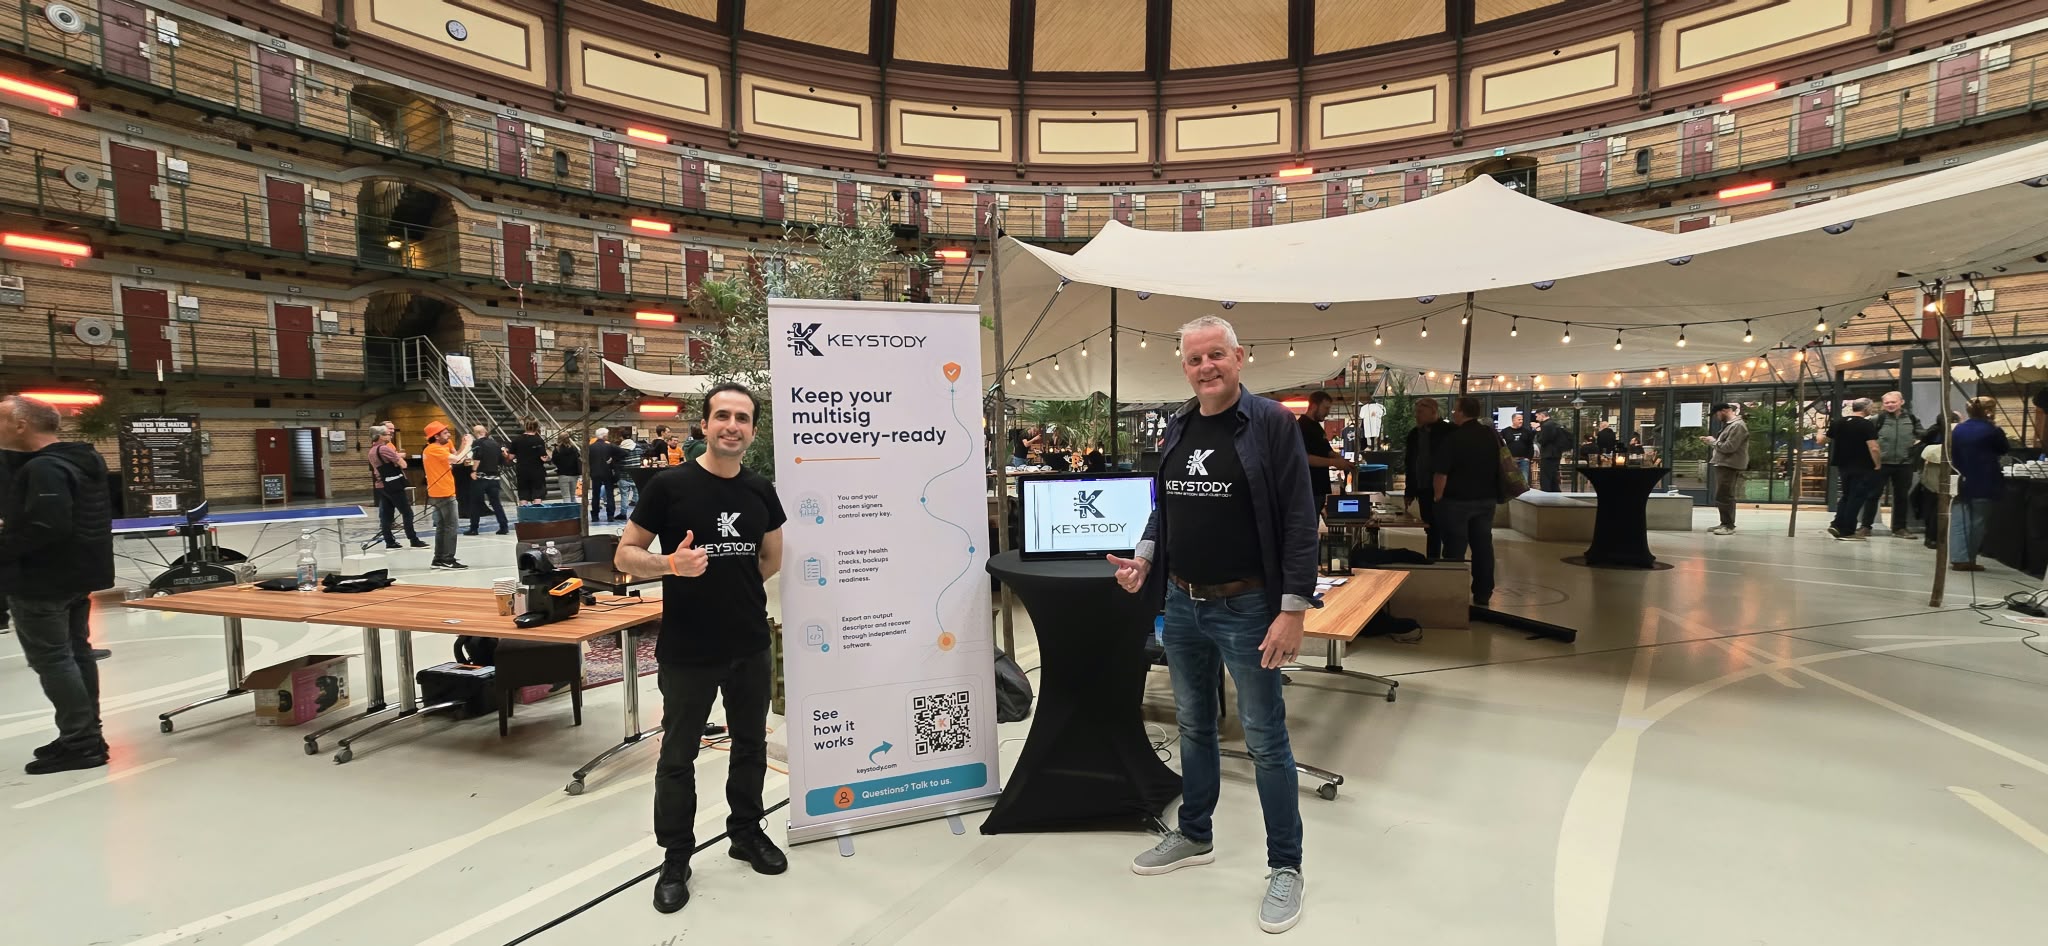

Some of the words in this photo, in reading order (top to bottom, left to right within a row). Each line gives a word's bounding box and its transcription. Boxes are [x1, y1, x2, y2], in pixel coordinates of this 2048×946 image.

[828, 334, 927, 348] KEYSTODY
[791, 387, 843, 406] Keep
[849, 391, 892, 406] your
[793, 407, 870, 427] multisig
[793, 427, 946, 447] recovery-ready
[1166, 480, 1232, 492] KEYSTODY
[1052, 523, 1127, 534] KEYSTODY
[868, 629, 907, 637] independent
[813, 710, 838, 721] See
[814, 724, 841, 736] how
[846, 720, 855, 731] it
[814, 736, 854, 750] works
[857, 763, 897, 774] keystody.com
[862, 784, 909, 799] Questions?
[911, 781, 928, 790] Talk
